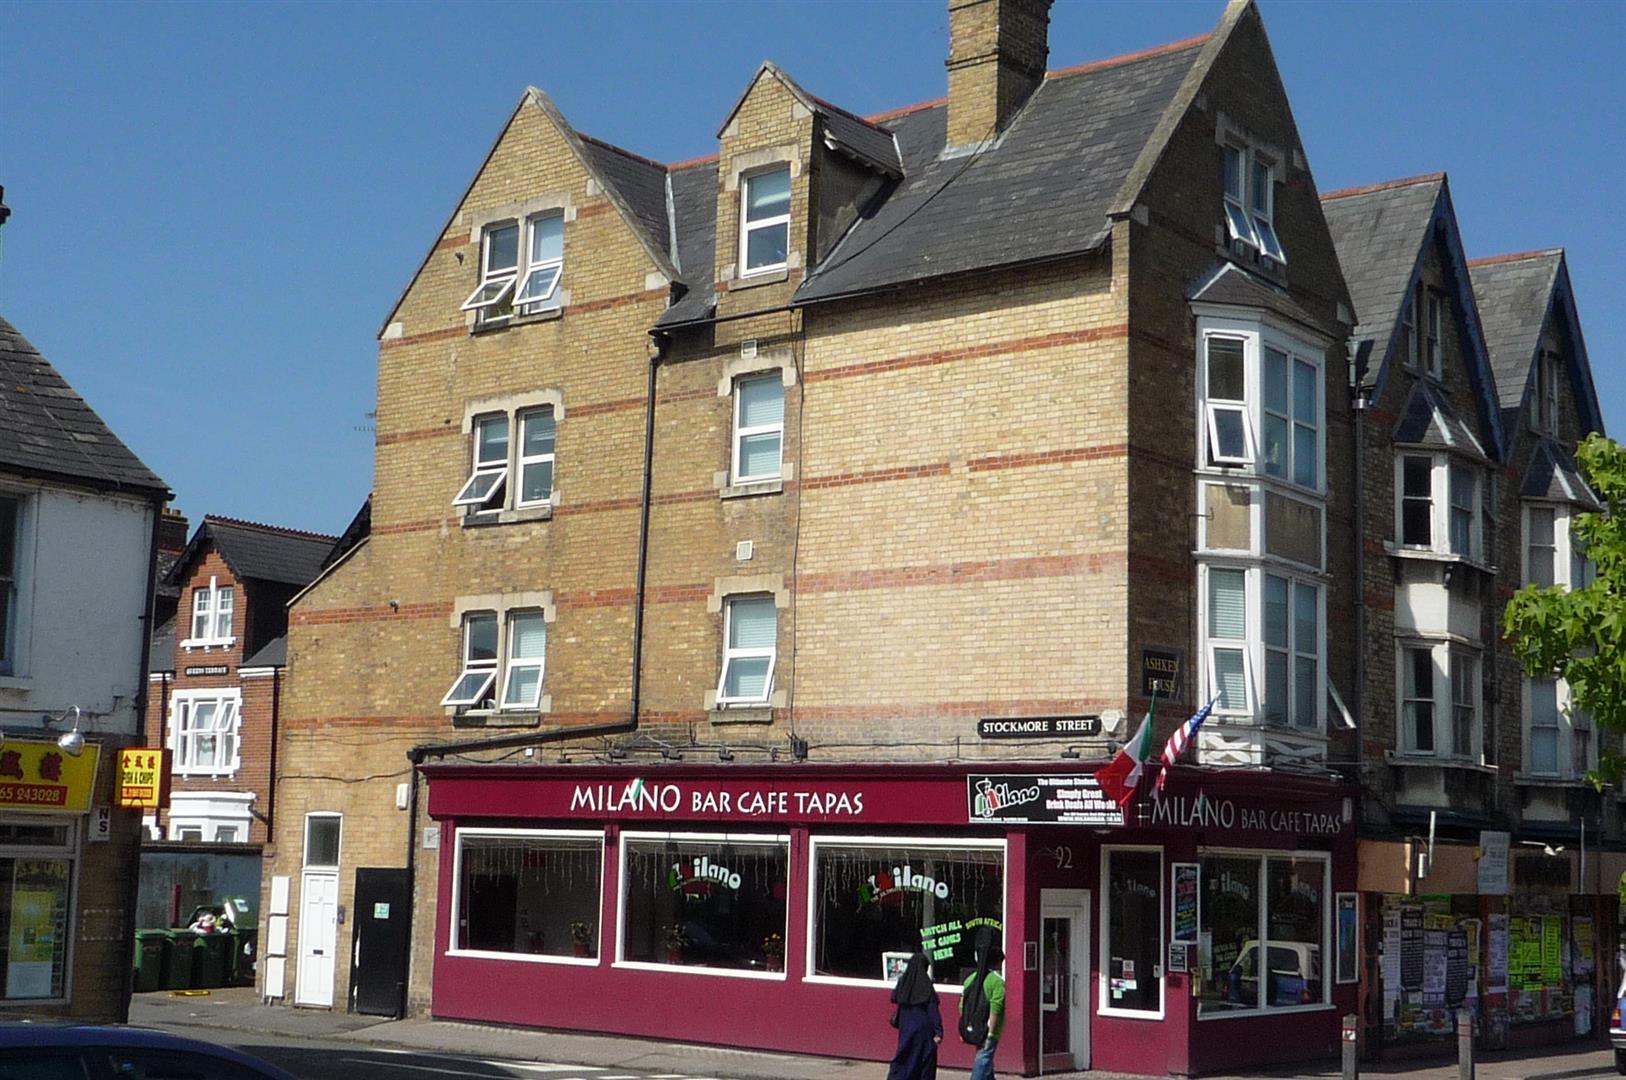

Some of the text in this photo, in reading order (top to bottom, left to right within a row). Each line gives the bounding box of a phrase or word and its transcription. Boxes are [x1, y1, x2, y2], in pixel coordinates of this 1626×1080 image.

[983, 719, 1094, 733] STOCKMORE STREET
[570, 784, 863, 815] MILANO BAR CAFE TAPAS
[1152, 797, 1341, 835] MILANO BAR CAFE TAPAS
[1056, 846, 1073, 869] 92
[920, 919, 962, 937] WATCH ALL
[965, 917, 983, 930] SOUTH
[921, 932, 961, 950] THE GAMES
[933, 946, 954, 960] HERE
